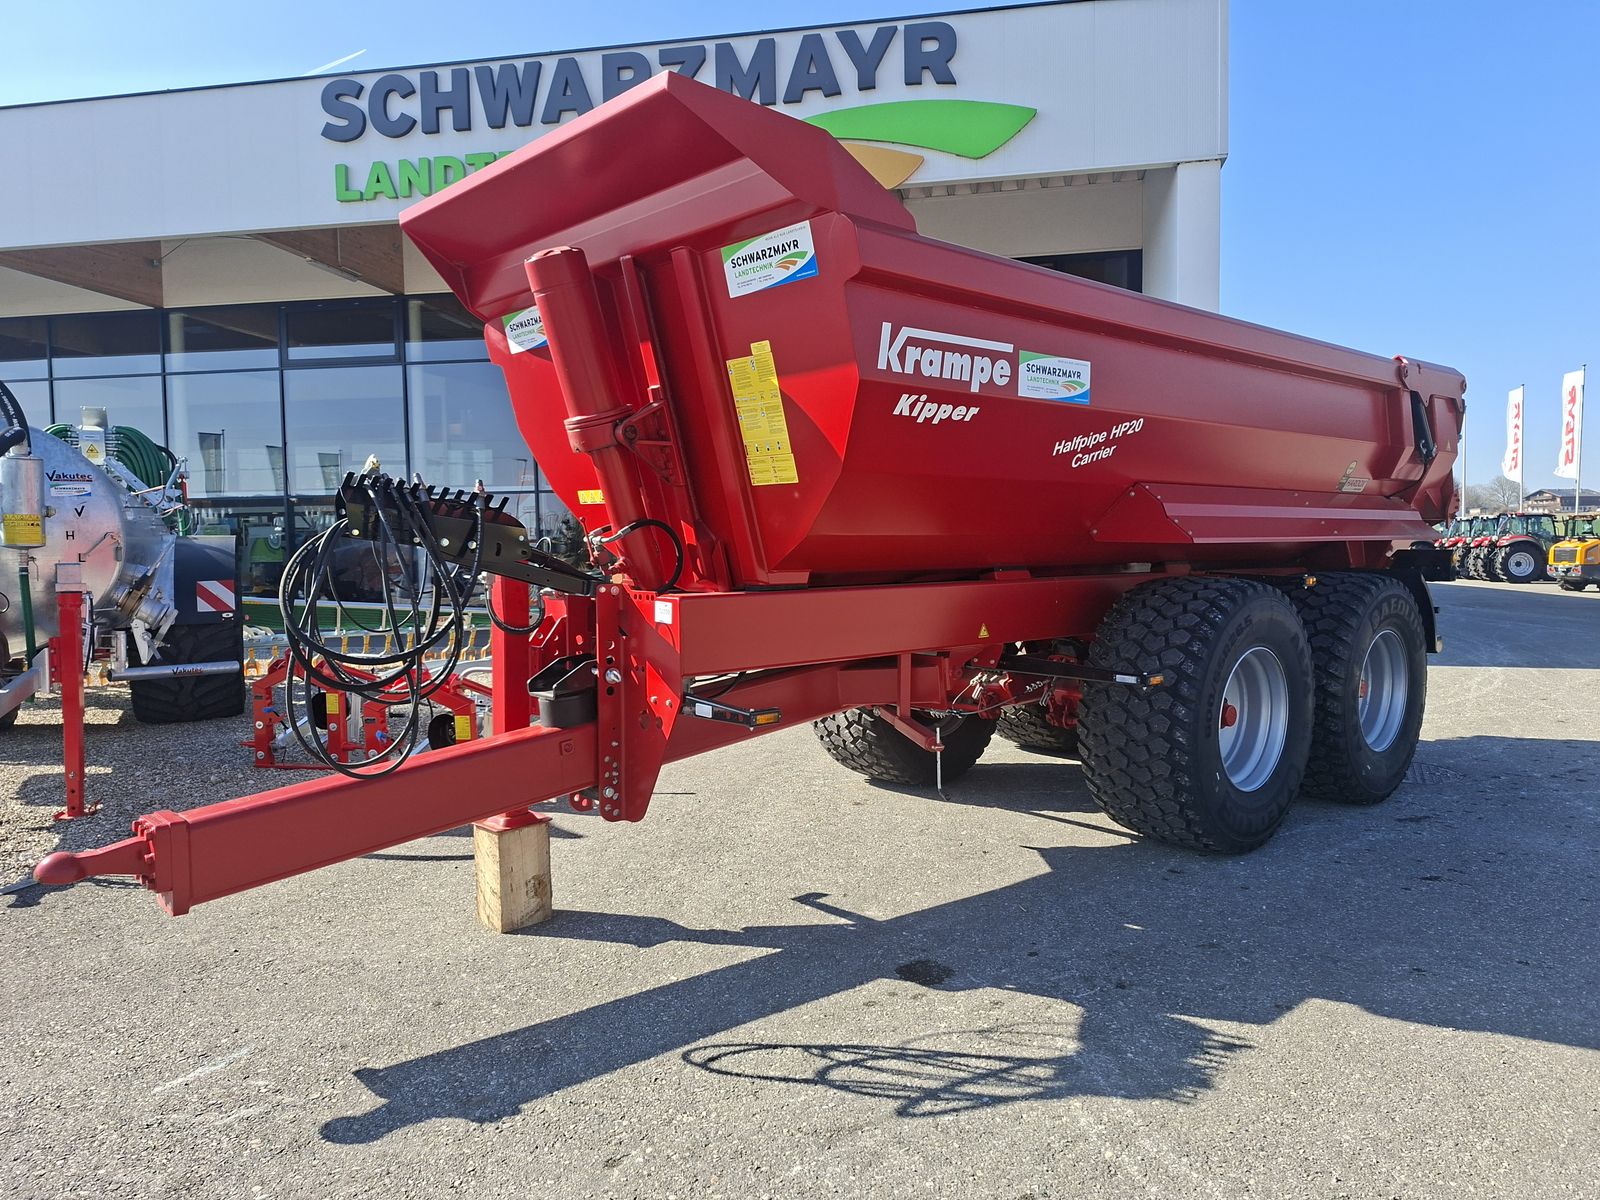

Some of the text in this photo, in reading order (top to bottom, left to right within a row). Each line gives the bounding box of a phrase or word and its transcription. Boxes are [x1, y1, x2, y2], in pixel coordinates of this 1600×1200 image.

[335, 150, 515, 203] LANDT
[731, 239, 800, 269] SCHWARZMAYR
[734, 261, 774, 279] LANDTECHNIK
[509, 316, 542, 332] SCHWARZMA
[877, 321, 1014, 393] Krampe
[1026, 363, 1082, 380] SCHWARZMAYR
[892, 393, 980, 425] Kipper
[1052, 418, 1144, 456] Halfpipe HP20
[1071, 445, 1117, 468] Carrier
[45, 469, 93, 481] Vakutec
[74, 505, 85, 517] V
[65, 530, 75, 540] H
[78, 553, 86, 563] L
